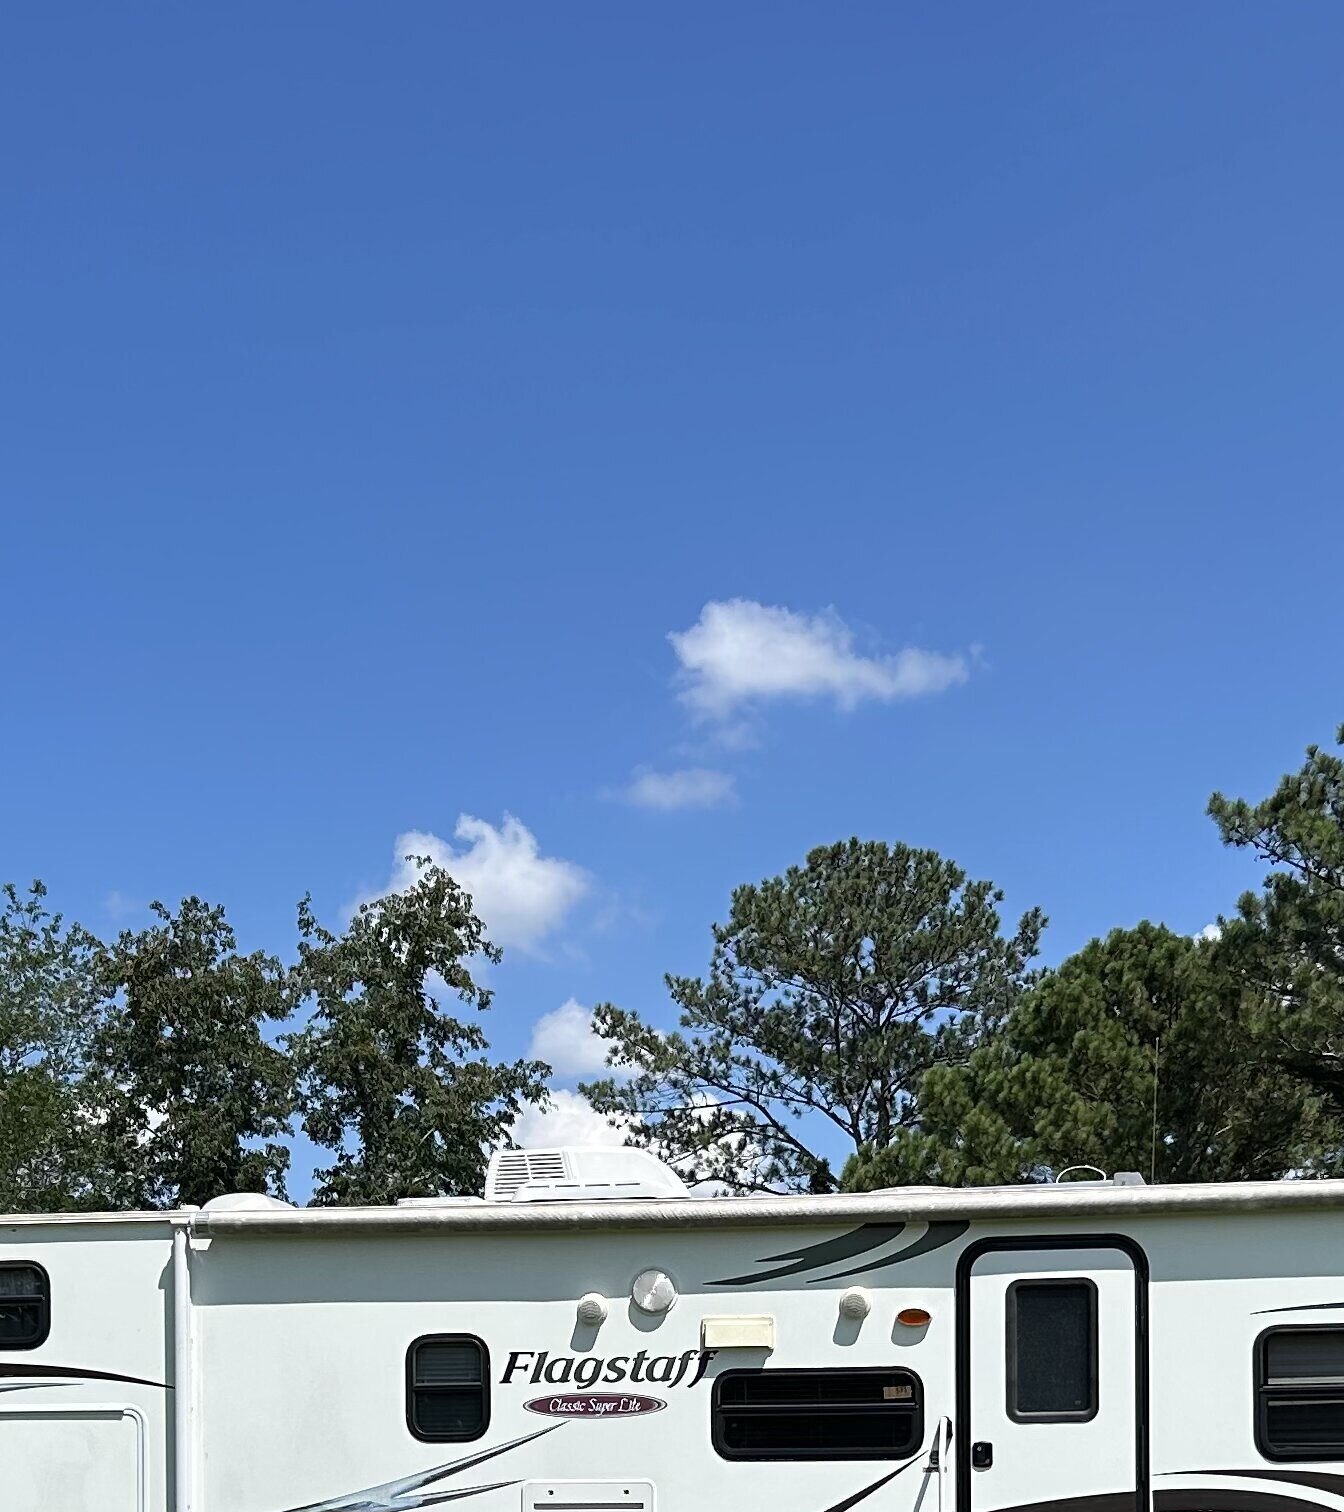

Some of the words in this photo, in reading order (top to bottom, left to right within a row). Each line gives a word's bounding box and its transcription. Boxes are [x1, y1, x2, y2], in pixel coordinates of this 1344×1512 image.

[499, 1350, 719, 1389] Flagstaff
[549, 1398, 586, 1412] Classic
[588, 1398, 617, 1415] Super
[618, 1398, 641, 1412] Lite
